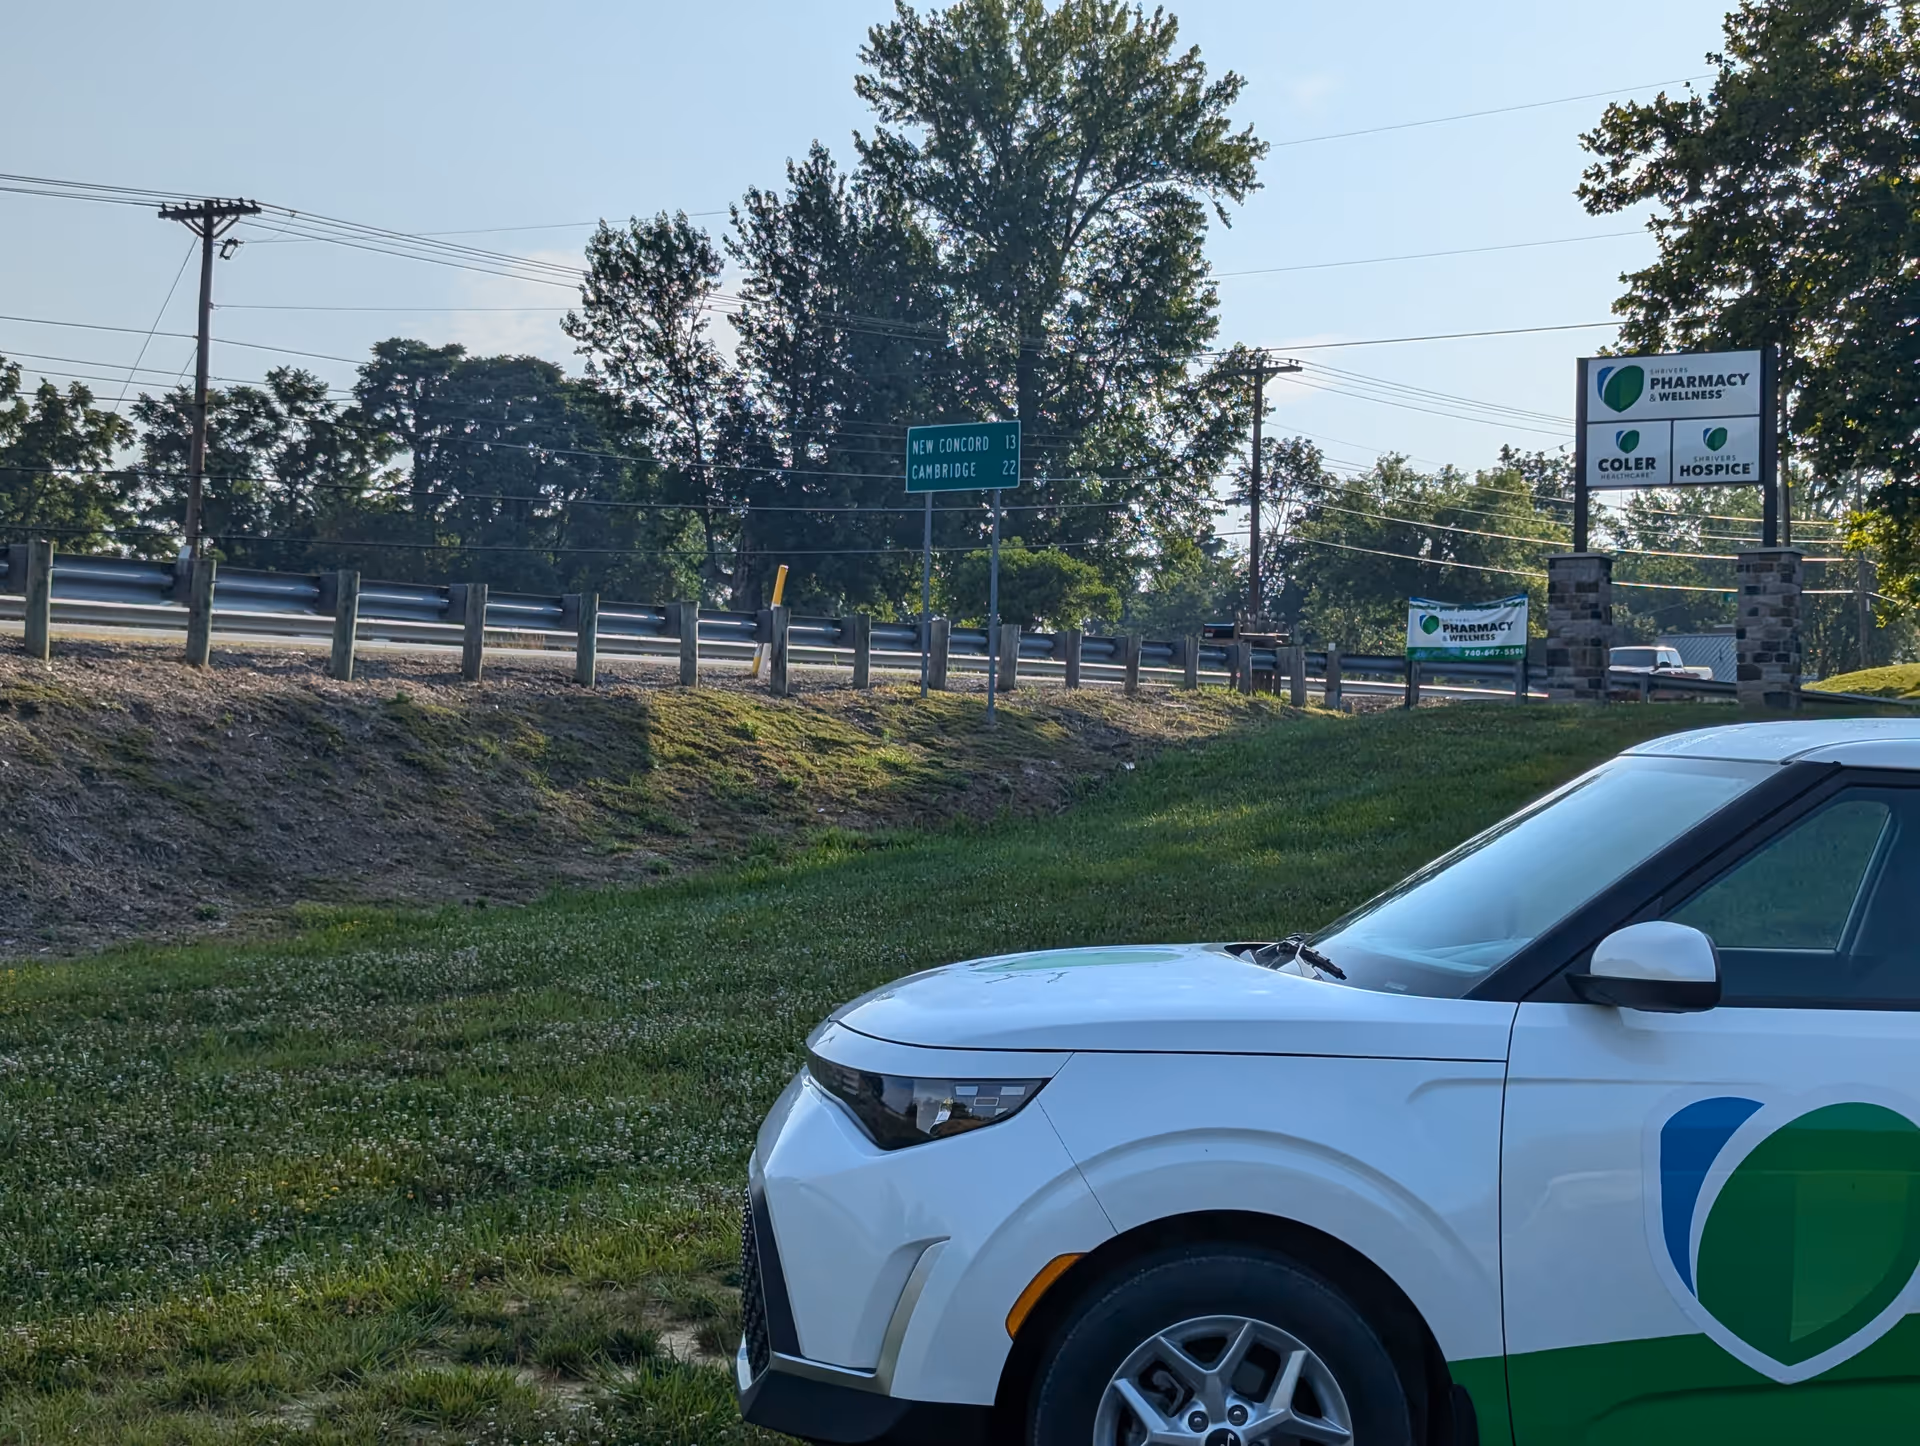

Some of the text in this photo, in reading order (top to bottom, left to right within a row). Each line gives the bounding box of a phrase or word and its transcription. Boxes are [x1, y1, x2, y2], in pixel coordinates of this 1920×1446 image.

[1650, 367, 1689, 375] SHRIVERS
[1650, 373, 1750, 390] PHARMACY
[1649, 389, 1723, 402] & WELLNESS
[912, 434, 1016, 455] NEW CONCORD 13
[912, 460, 1016, 480] CAMBRIDGE 22
[1598, 457, 1656, 472] COLER
[1679, 463, 1751, 477] HOSPICE
[1600, 472, 1650, 480] HEALTHCARE
[1442, 621, 1514, 633] PHARMACY
[1449, 633, 1496, 642] WELLNESS
